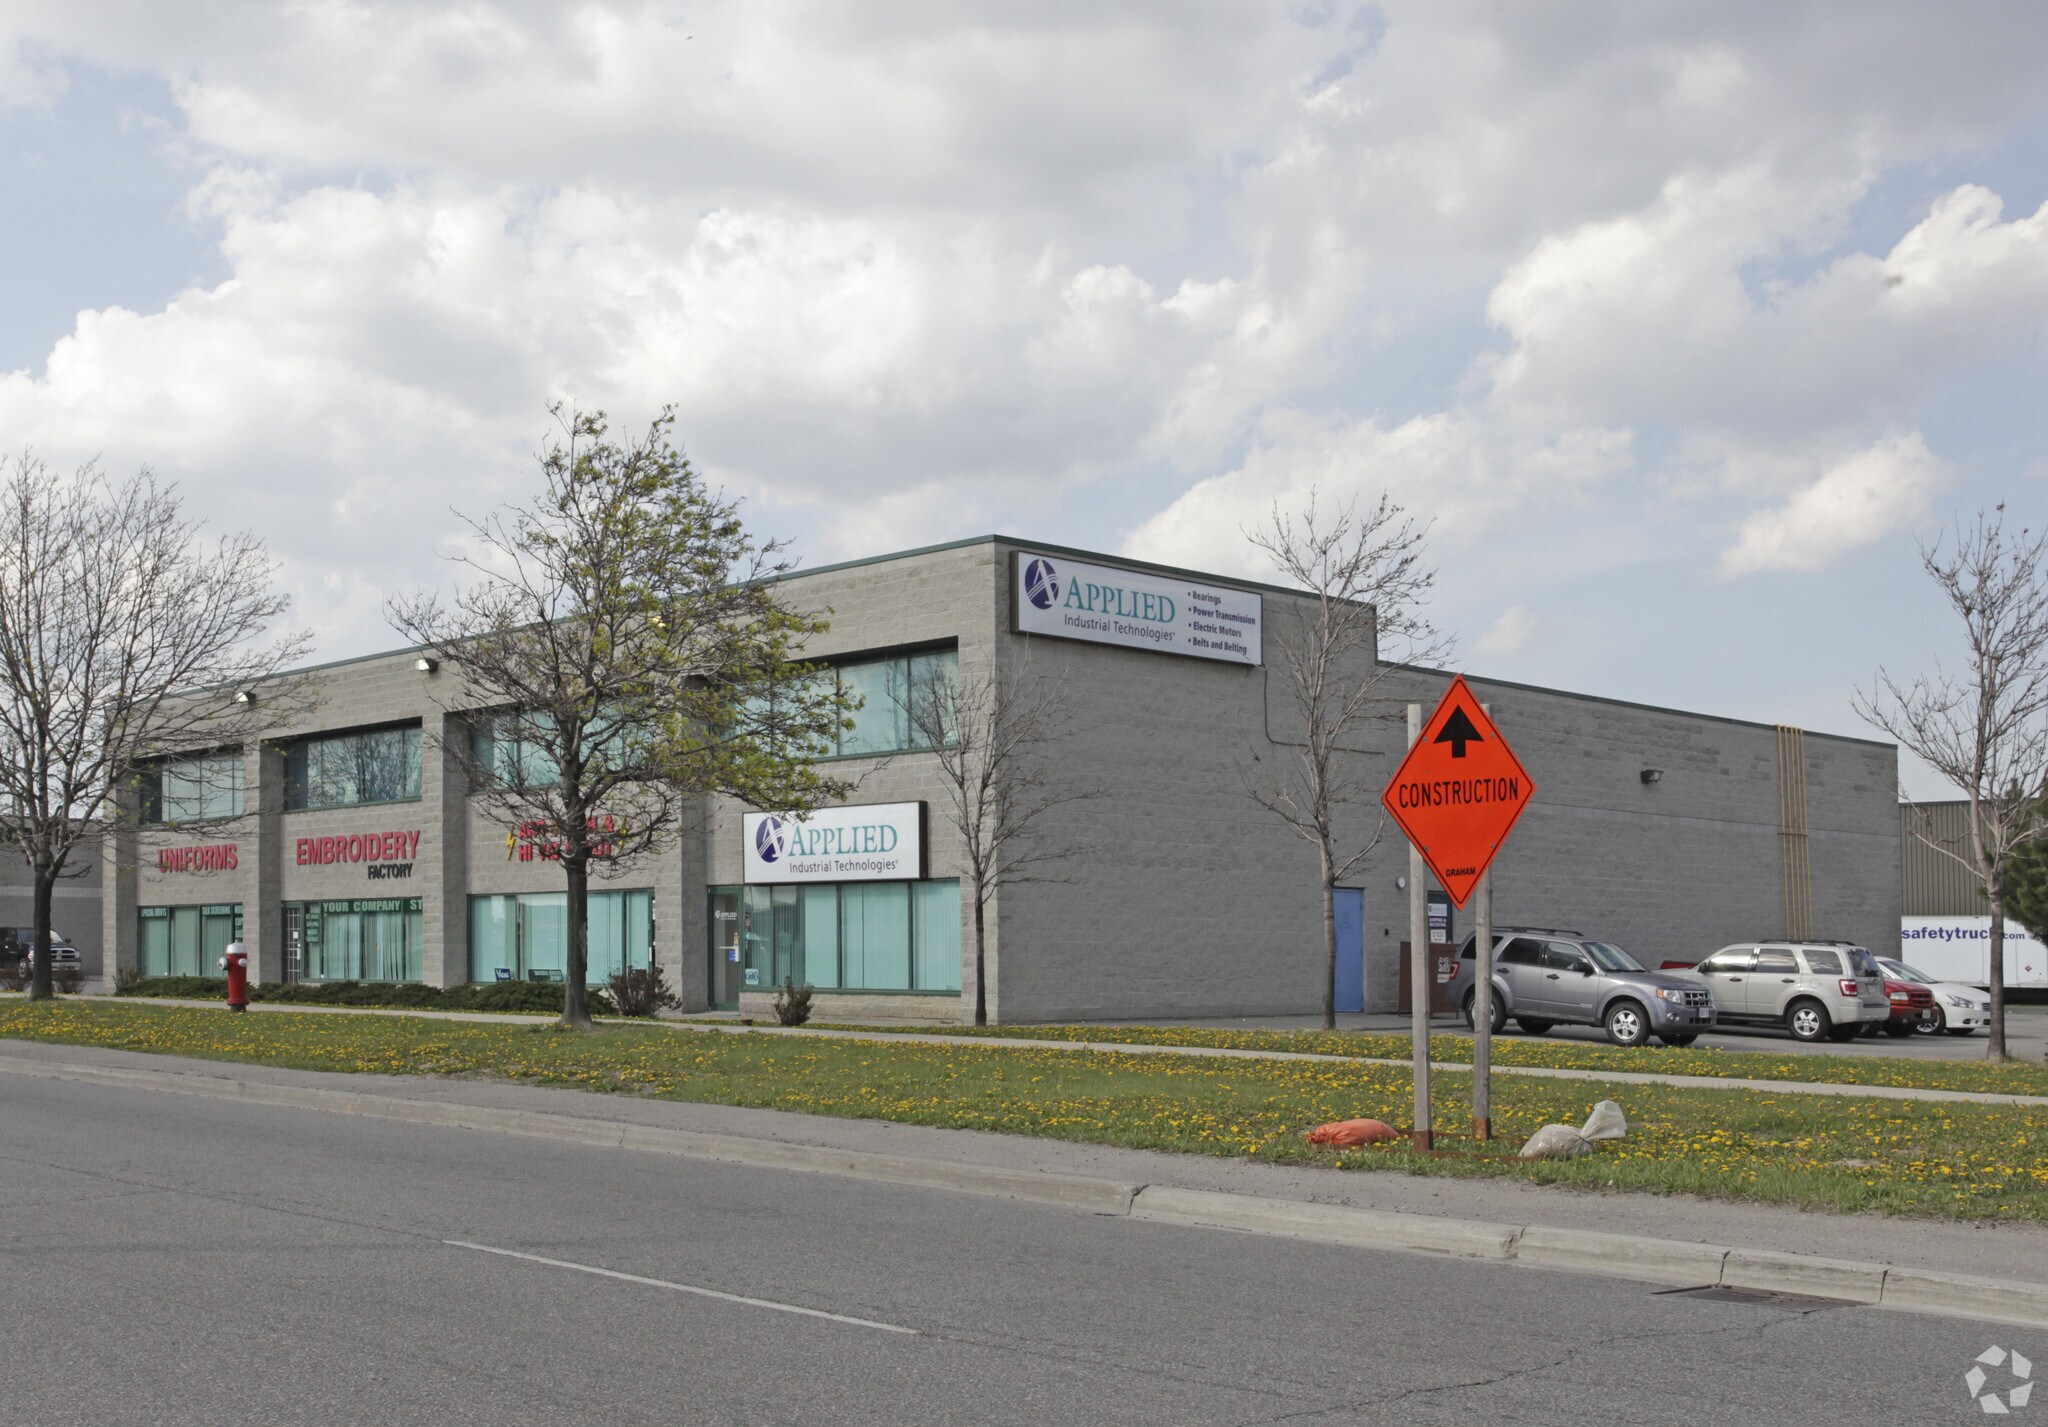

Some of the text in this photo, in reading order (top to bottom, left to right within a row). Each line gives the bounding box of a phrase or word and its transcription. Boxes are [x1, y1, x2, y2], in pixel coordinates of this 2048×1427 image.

[1063, 576, 1176, 623] APPLIED
[1192, 591, 1221, 605] Bearings
[1193, 606, 1256, 625] Power Transmission
[1064, 614, 1173, 642] Industrial Technologies
[1193, 621, 1242, 638] Electric Motors
[1193, 637, 1247, 655] Belts and Belting
[1399, 777, 1519, 808] CONSTRUCTION
[296, 830, 420, 865] EMBROIDERY
[788, 824, 898, 857] APPLIED
[158, 843, 238, 873] UNIFORMS
[789, 858, 896, 873] Industrial Technologies
[368, 863, 413, 879] FACTORY
[1445, 867, 1476, 877] GRAHAM
[323, 902, 349, 913] YOUR
[353, 900, 400, 912] COMPANY
